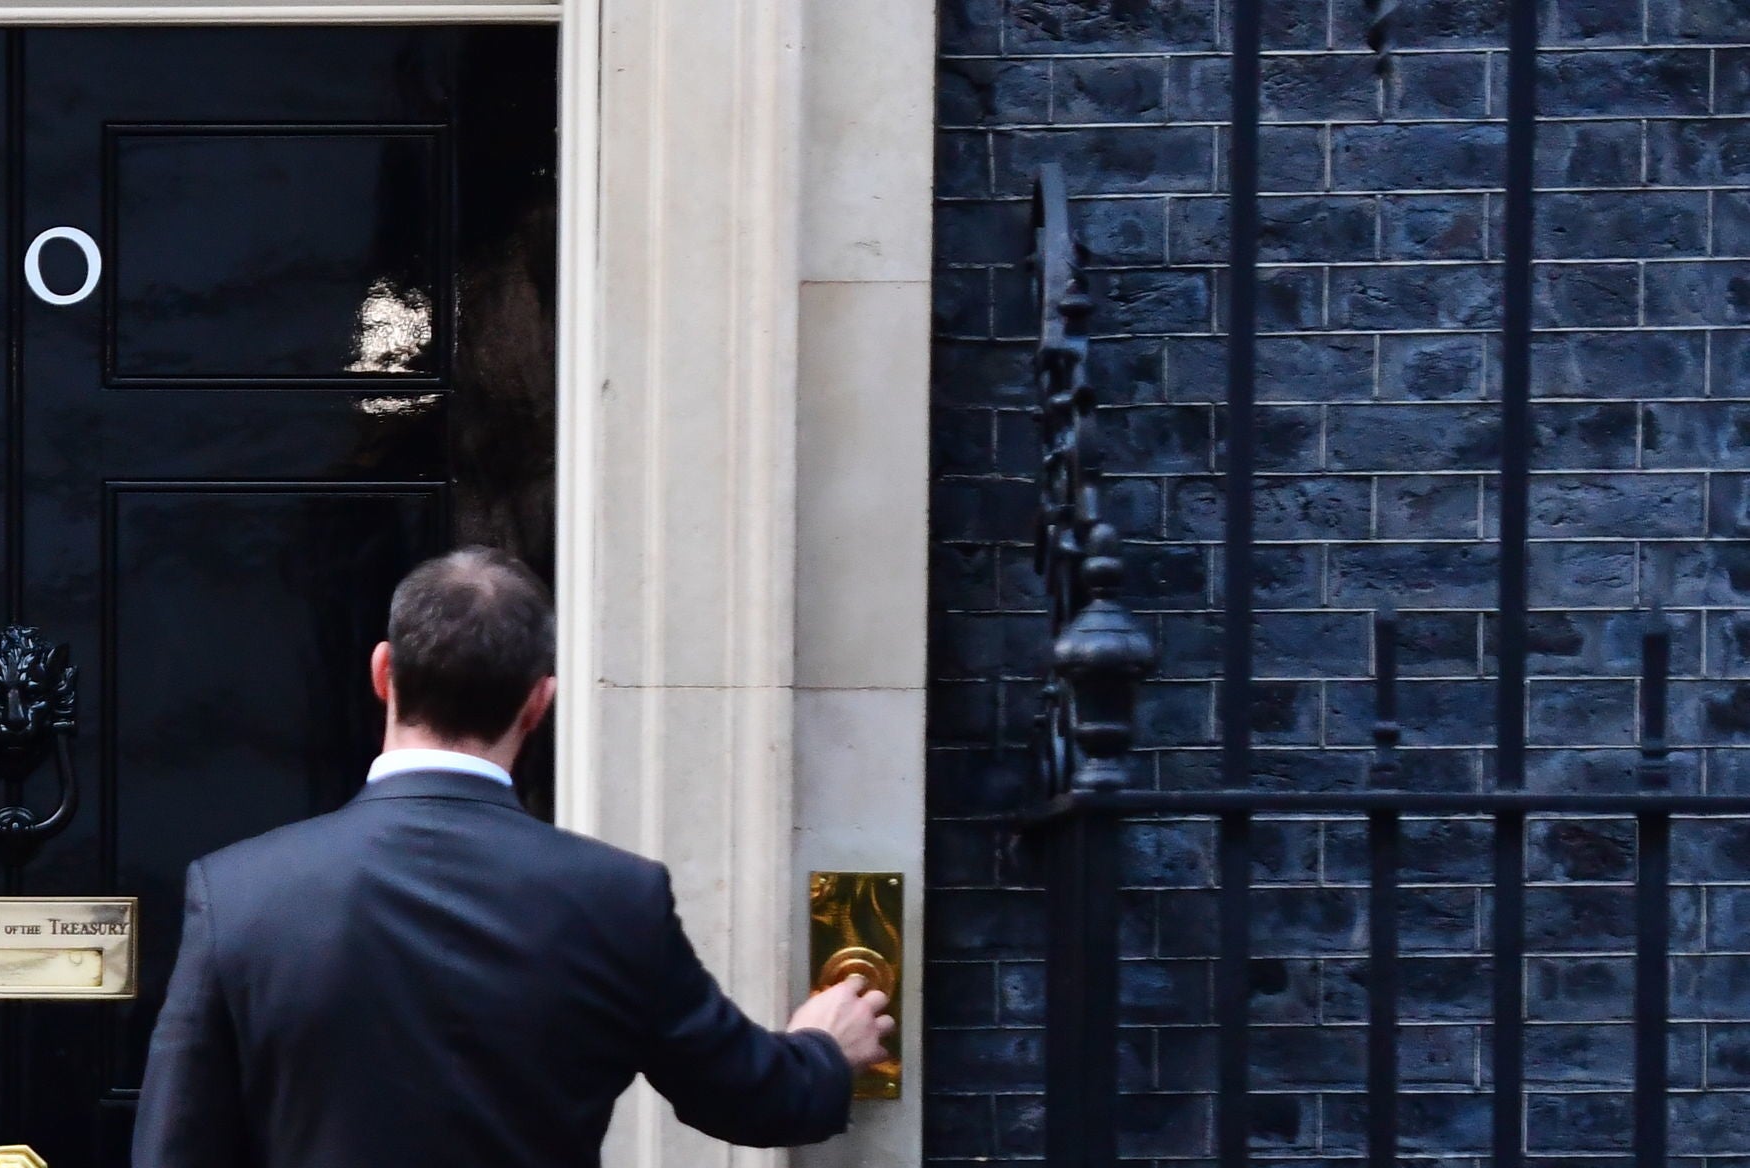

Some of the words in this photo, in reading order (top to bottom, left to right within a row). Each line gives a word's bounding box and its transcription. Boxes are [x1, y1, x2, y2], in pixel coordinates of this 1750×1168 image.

[4, 925, 19, 935] OF
[20, 925, 42, 935] THE
[46, 918, 130, 936] TREASURY
